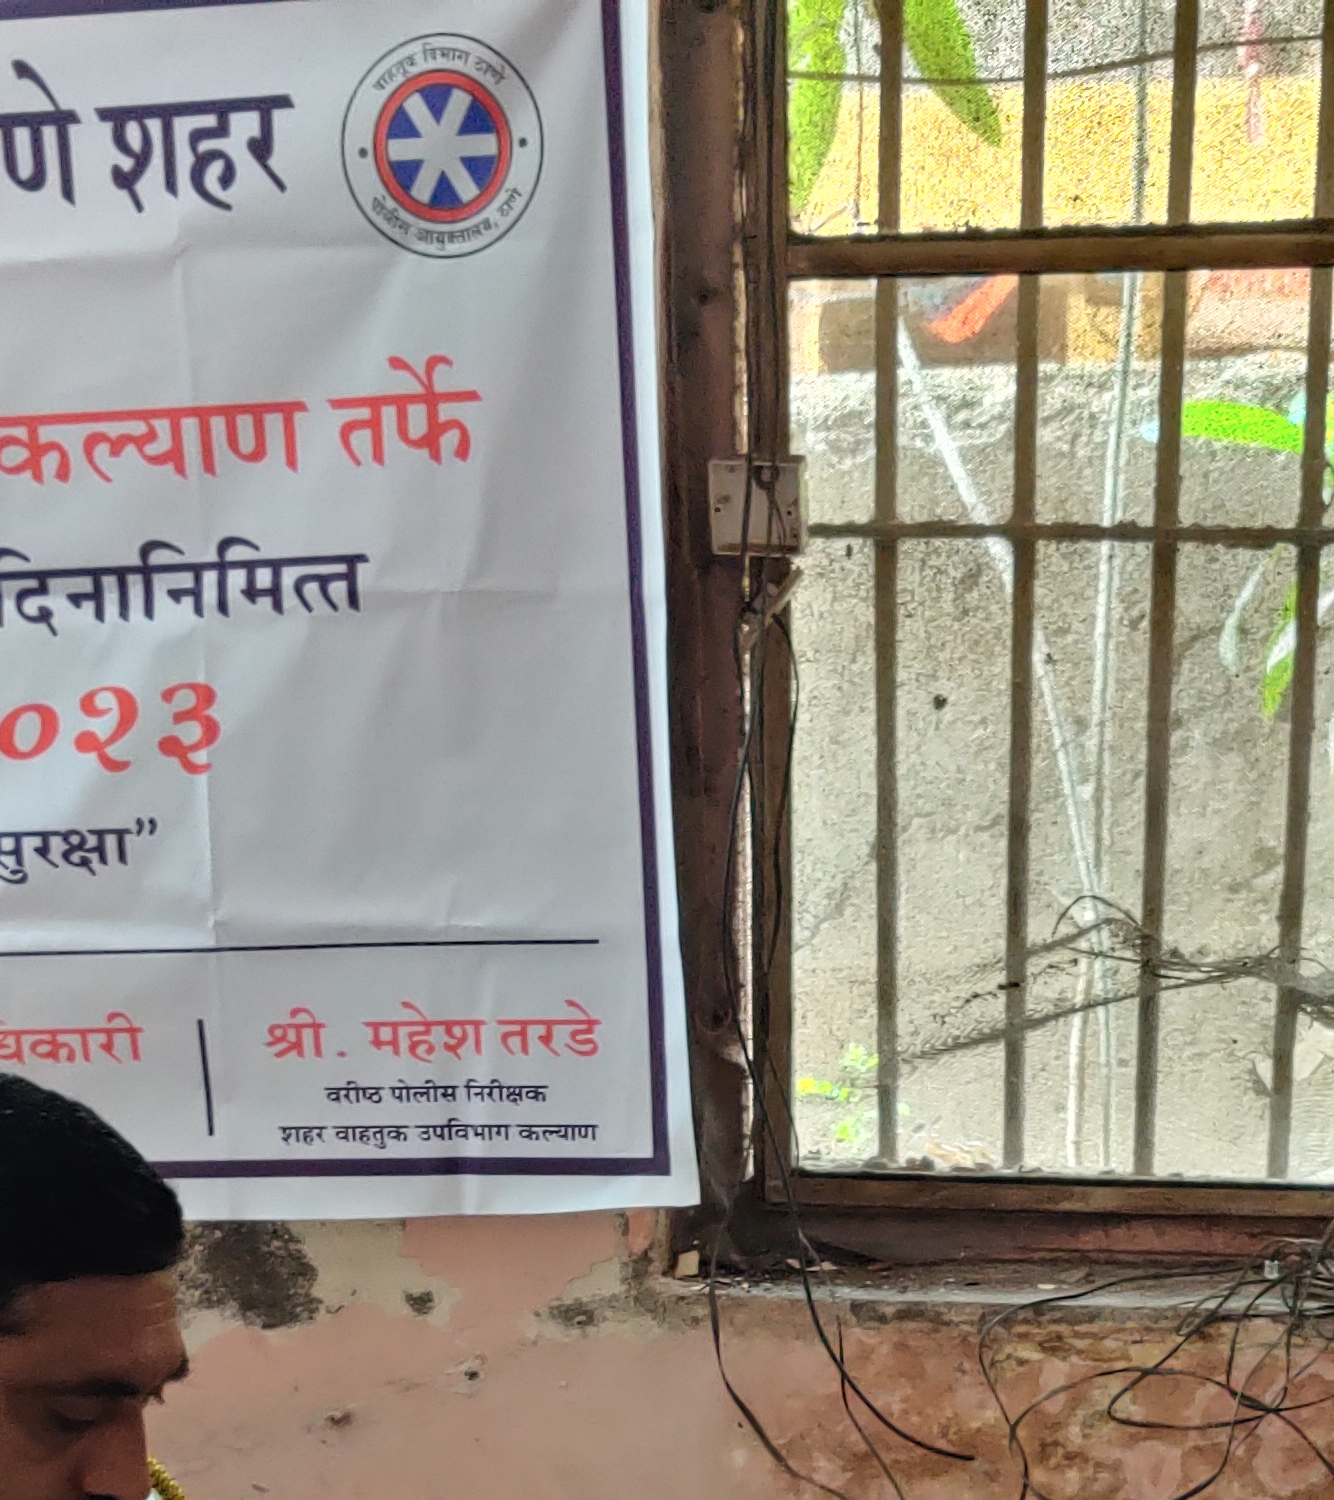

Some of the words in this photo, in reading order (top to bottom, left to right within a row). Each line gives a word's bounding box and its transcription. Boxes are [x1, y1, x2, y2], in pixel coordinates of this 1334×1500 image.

[94, 93, 295, 214] शहर
[326, 354, 482, 467] तर्फे
[362, 1001, 487, 1064] महेश
[496, 999, 602, 1057] तरडे
[390, 1079, 459, 1103] पोलीस
[464, 1080, 549, 1106] निरीक्षक
[278, 1126, 328, 1146] शहर
[333, 1126, 409, 1150] वाहतुक
[415, 1119, 512, 1143] उपविभाग
[516, 1124, 600, 1143] कल्याण
